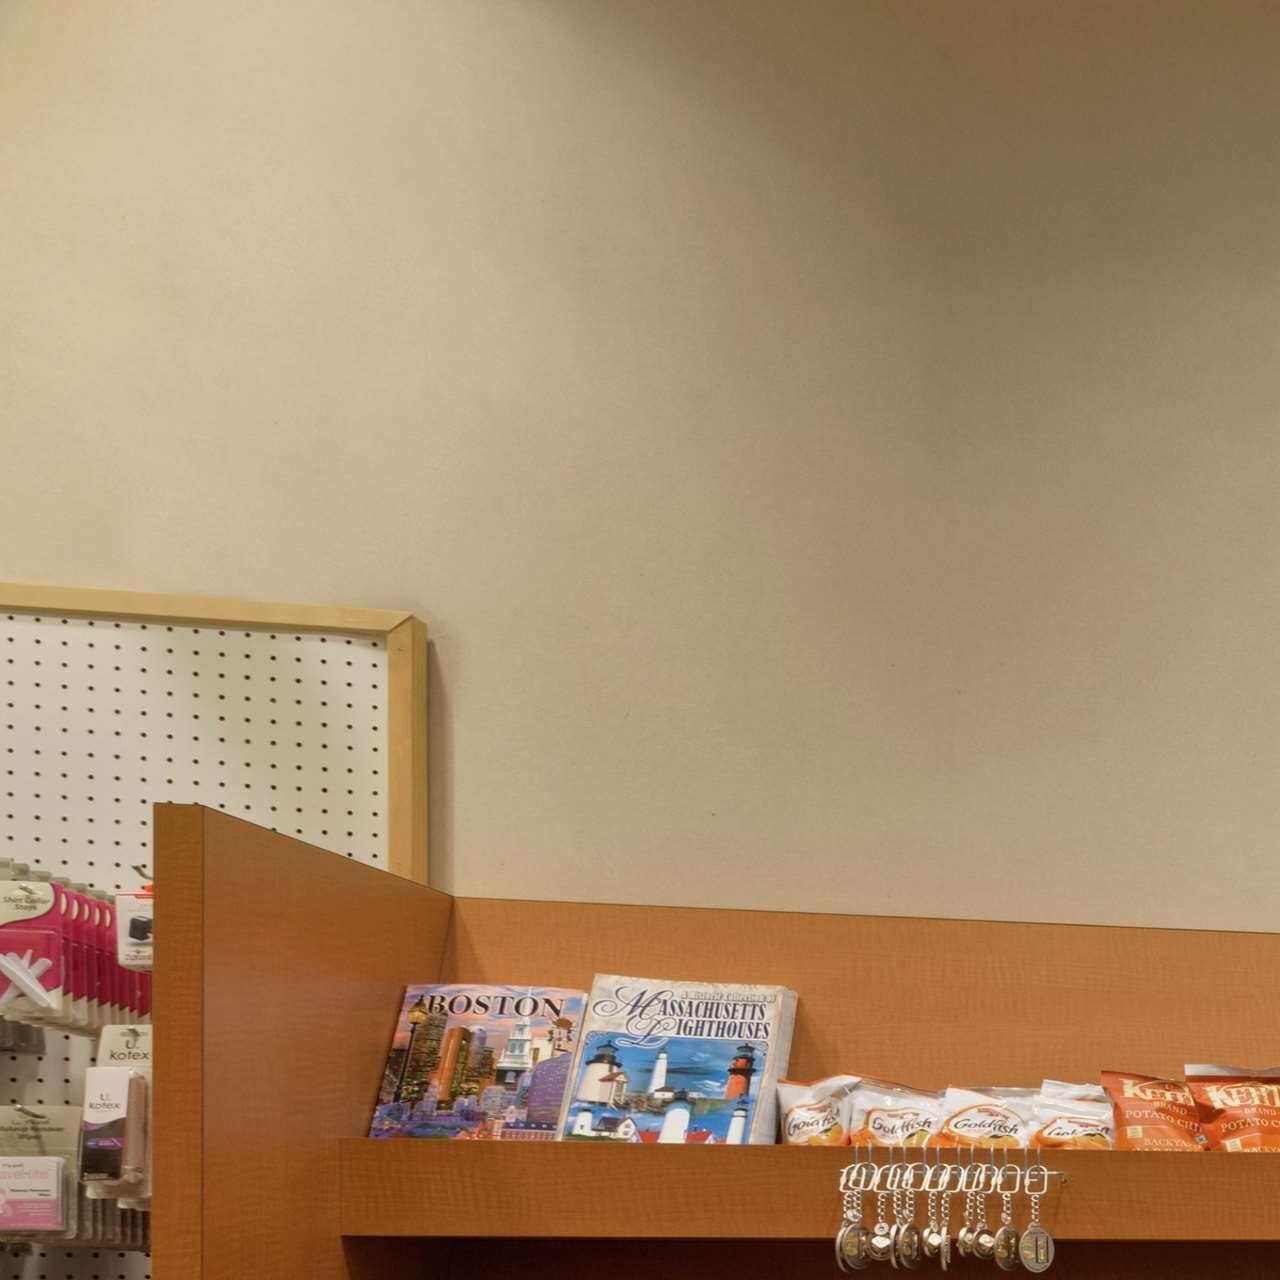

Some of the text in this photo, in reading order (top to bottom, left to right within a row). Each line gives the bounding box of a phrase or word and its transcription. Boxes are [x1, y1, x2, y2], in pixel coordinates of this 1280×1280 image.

[425, 992, 566, 1019] BOSTON
[593, 986, 768, 1021] MASSACHUSETTS
[615, 1015, 771, 1048] LIGHTHOUSES
[1125, 1110, 1174, 1125] POTATO
[1221, 1118, 1269, 1132] POTATO
